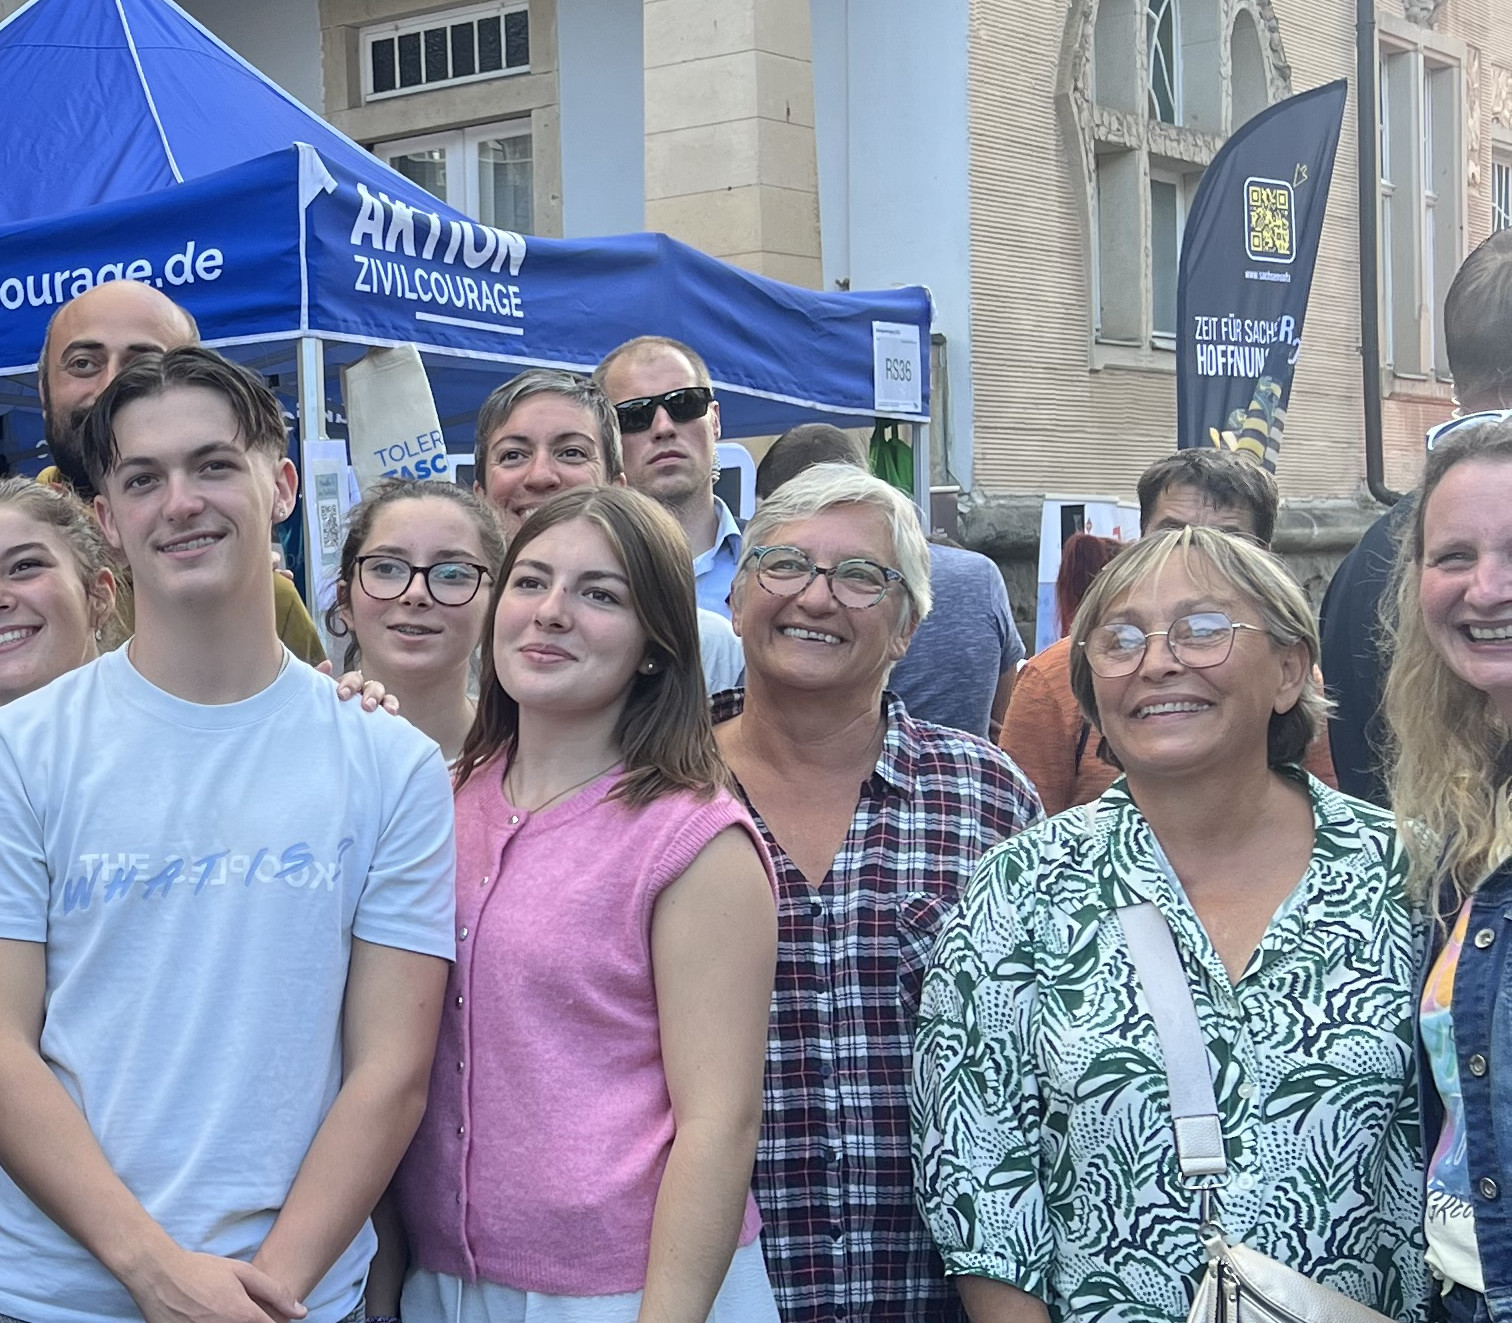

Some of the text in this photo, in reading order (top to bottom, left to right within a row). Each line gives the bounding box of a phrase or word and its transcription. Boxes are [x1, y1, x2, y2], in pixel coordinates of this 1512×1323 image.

[350, 182, 527, 276] AKTION
[353, 254, 524, 318] ZIVILCOURAGE
[1194, 316, 1218, 341] ZEIT
[1221, 313, 1242, 343] FÜR
[885, 357, 912, 382] RS36
[1196, 343, 1270, 378] HOFFNUN
[63, 849, 230, 917] WHAT
[80, 853, 150, 882] THE
